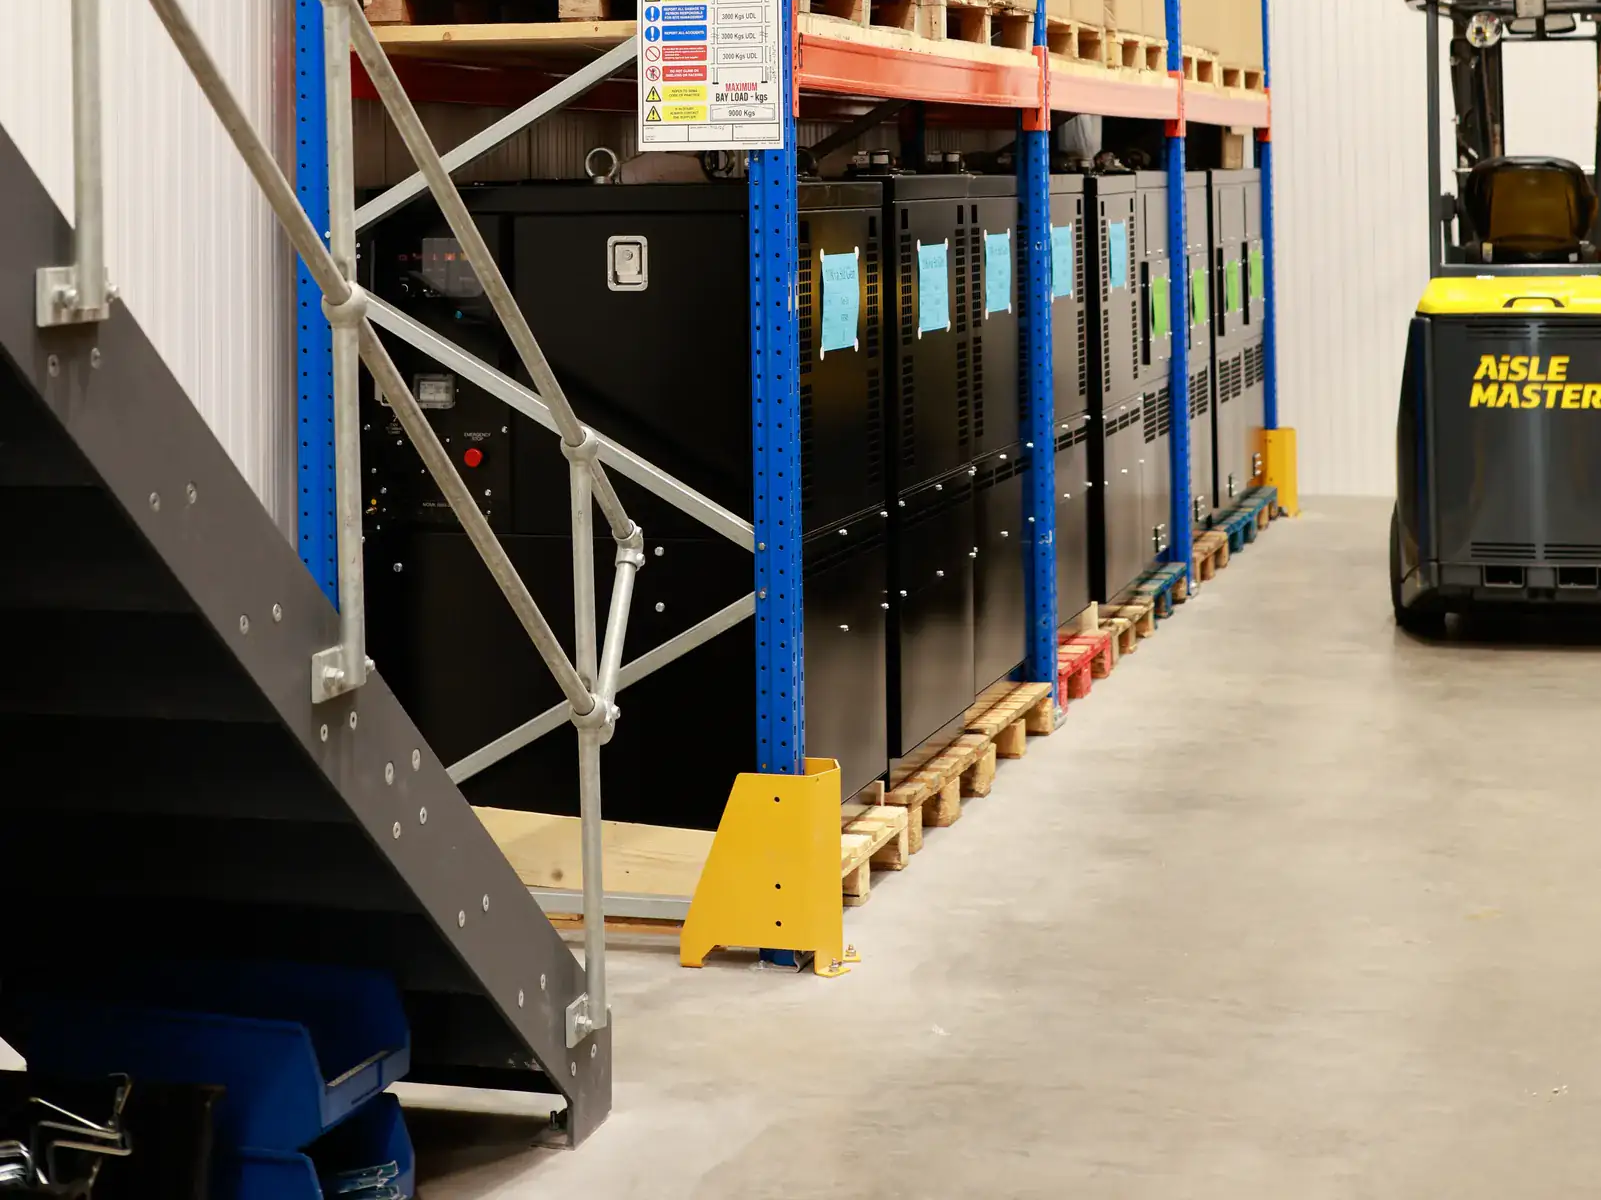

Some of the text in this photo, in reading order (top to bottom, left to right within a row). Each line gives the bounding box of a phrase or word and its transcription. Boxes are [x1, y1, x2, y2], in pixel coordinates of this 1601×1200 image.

[734, 12, 745, 21] Kgs
[745, 12, 757, 20] UDL
[734, 32, 745, 41] Kgs
[745, 32, 756, 40] UDL
[735, 52, 746, 61] Kgs
[746, 52, 758, 60] UDL
[725, 82, 758, 92] MAXIMUM
[715, 92, 729, 102] BAY
[730, 92, 749, 102] LOAD
[754, 91, 768, 104] kgs
[728, 109, 756, 119] 9000 Kgs
[1469, 382, 1601, 409] MASTER
